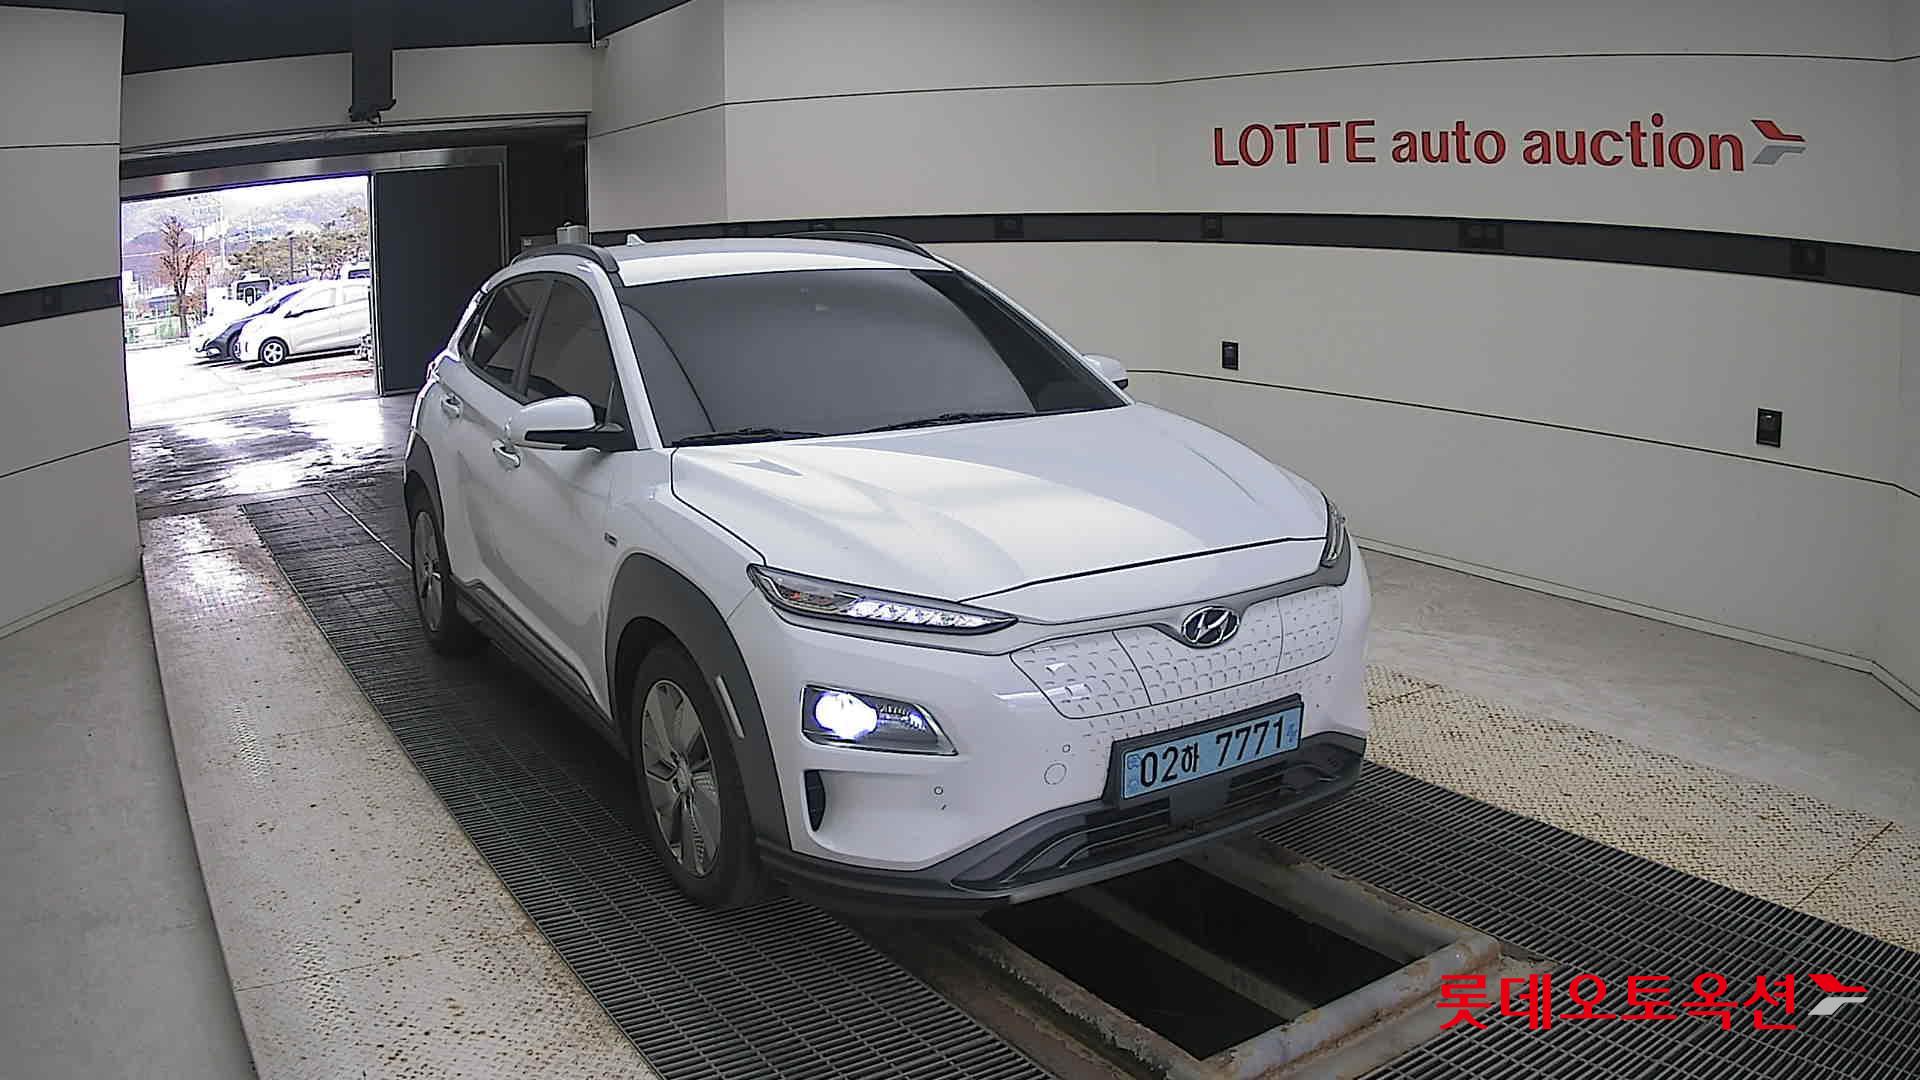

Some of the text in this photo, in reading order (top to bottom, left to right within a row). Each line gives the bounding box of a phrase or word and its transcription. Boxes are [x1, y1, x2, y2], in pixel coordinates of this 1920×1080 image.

[1214, 113, 1745, 172] LOTTE auto auction
[1139, 716, 1284, 788] 02하 7771
